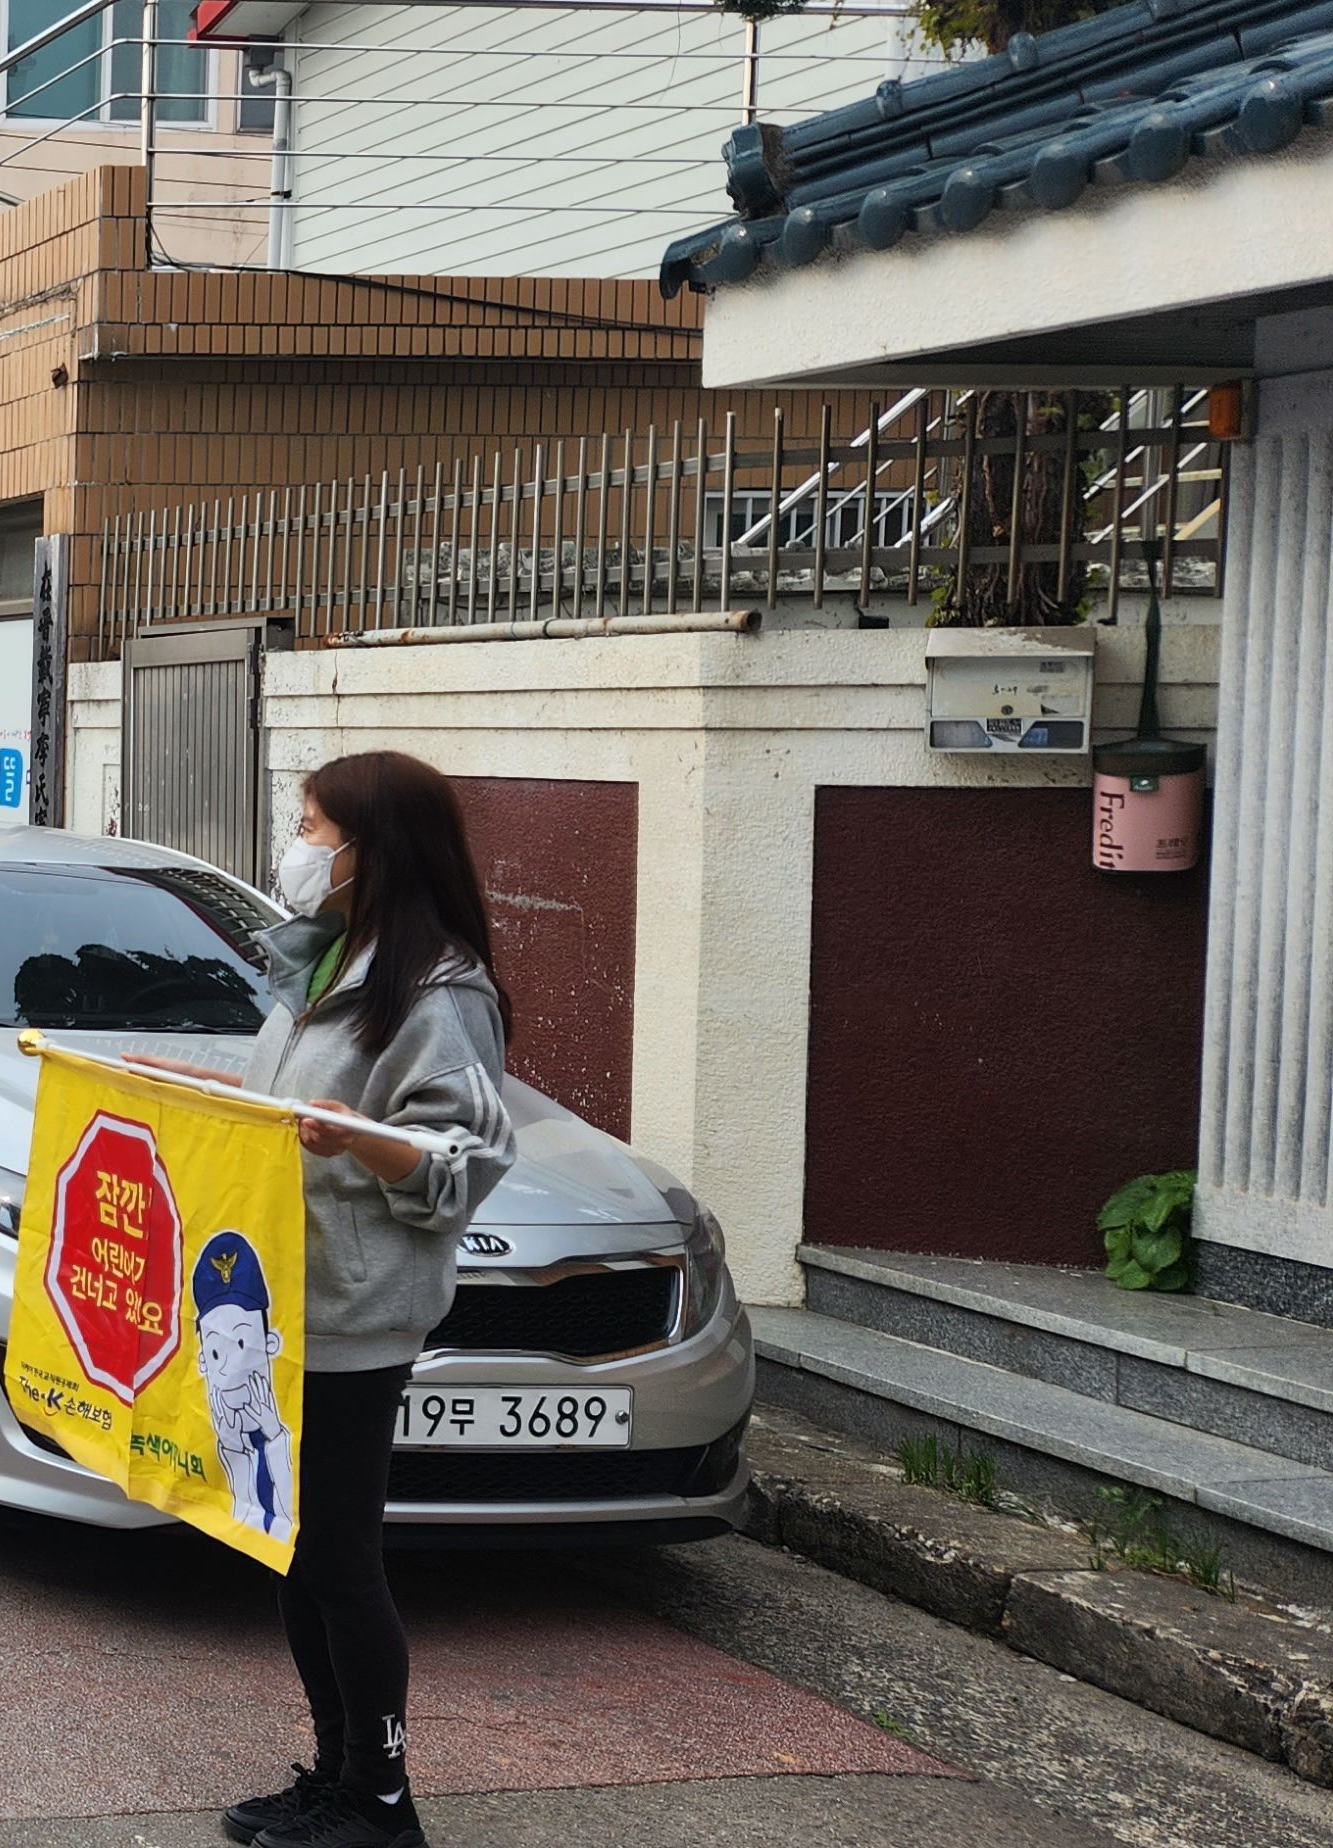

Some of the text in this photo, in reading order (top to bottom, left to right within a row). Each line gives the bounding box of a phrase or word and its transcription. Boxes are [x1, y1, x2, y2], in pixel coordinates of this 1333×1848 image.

[70, 1264, 118, 1312] 건너고
[63, 1397, 113, 1431] 손해보험
[398, 1394, 608, 1438] 19무 3689
